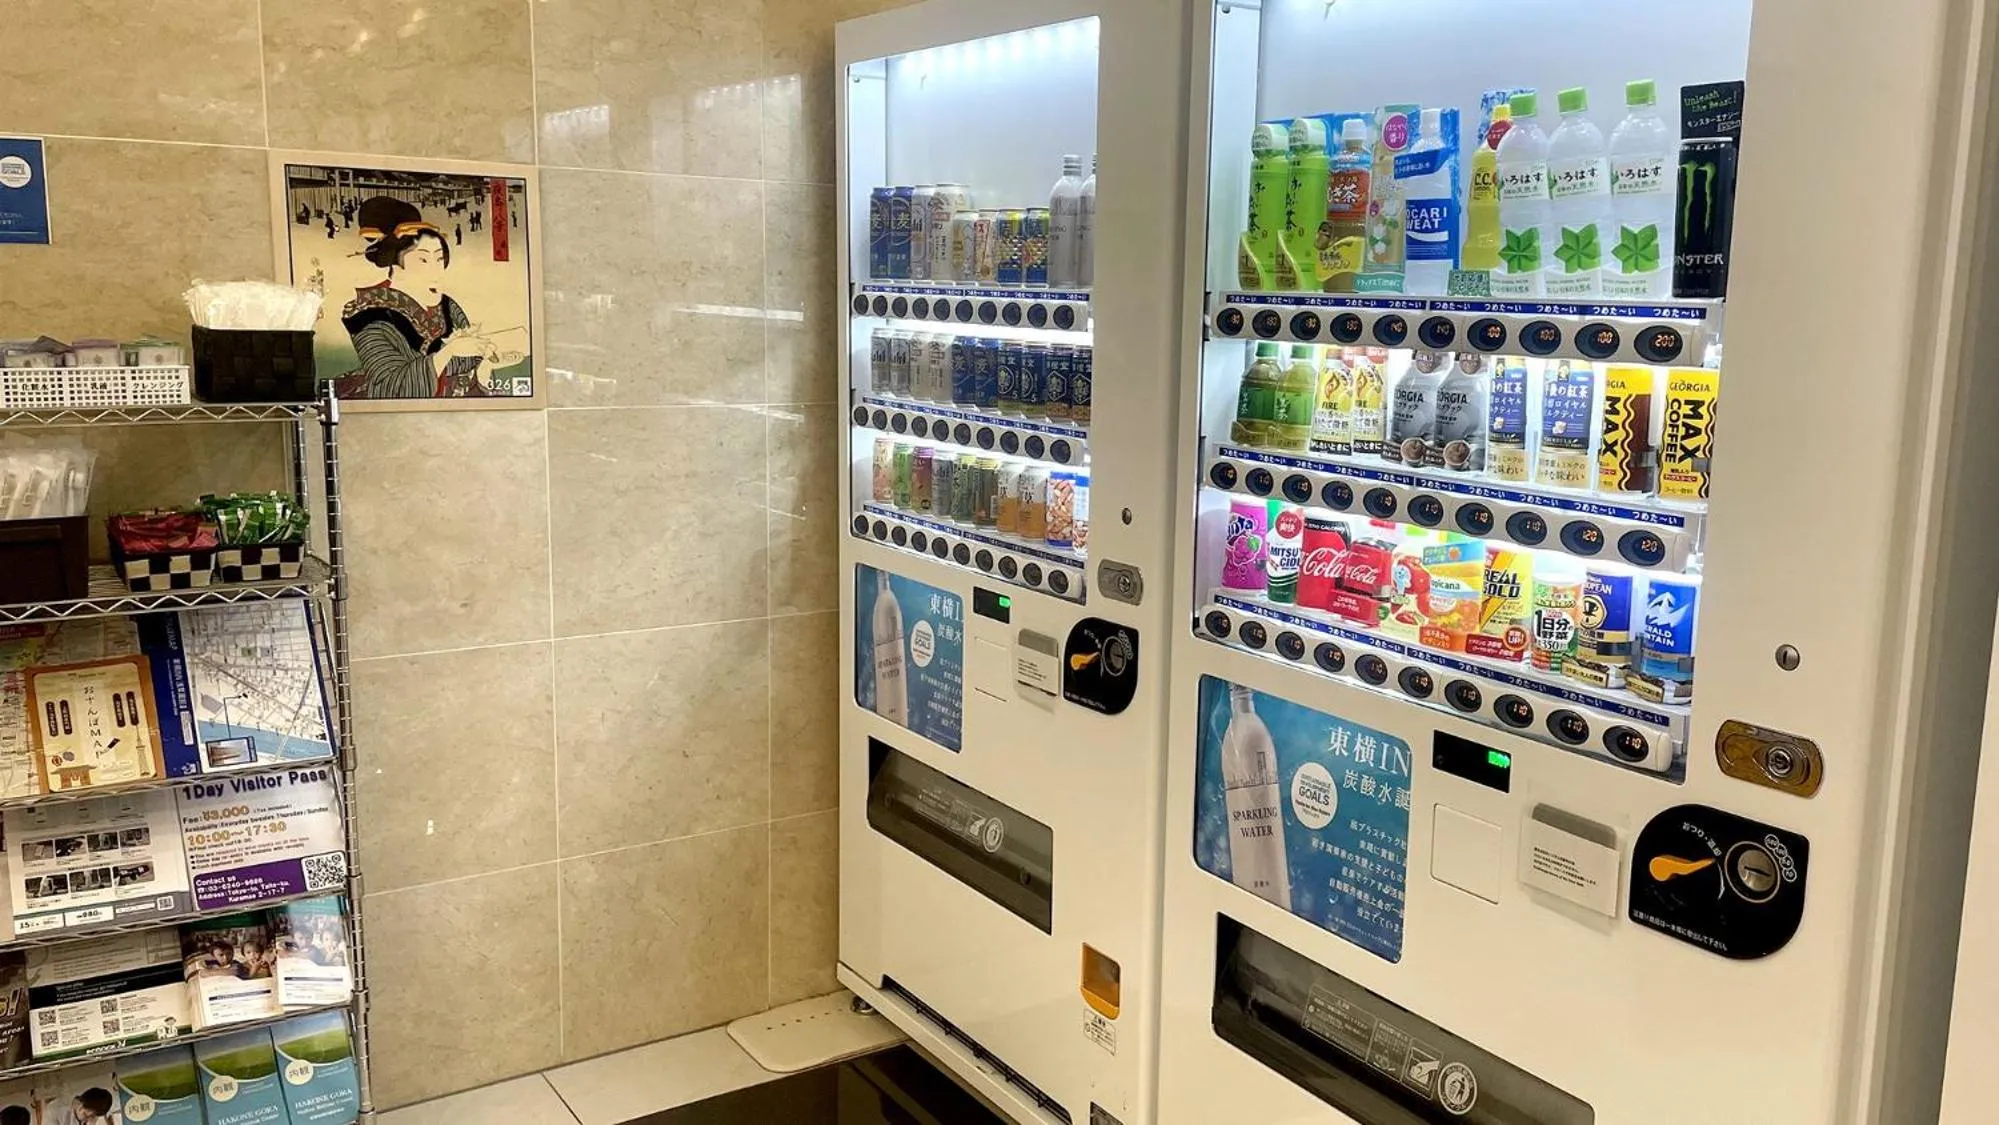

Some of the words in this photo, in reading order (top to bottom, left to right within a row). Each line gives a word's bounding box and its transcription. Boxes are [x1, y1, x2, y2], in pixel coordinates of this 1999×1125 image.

[1502, 172, 1544, 185] いろはす
[1554, 167, 1597, 182] いろはす
[1619, 165, 1662, 180] いろはす
[1406, 206, 1447, 219] OCARI
[1406, 218, 1440, 230] WEAT
[1435, 302, 1471, 310] つめた～い
[1484, 303, 1522, 312] つめた～い
[1536, 304, 1577, 314] つめた～い
[1592, 306, 1636, 316] つめた～い
[1652, 308, 1700, 318] つめた～い
[131, 381, 184, 389] クレンジング
[1669, 382, 1711, 392] GEORGIA
[1322, 401, 1339, 410] FIRE
[1602, 396, 1621, 458] MAX
[1665, 398, 1681, 464] COFFEE
[1678, 400, 1705, 464] MAX
[1270, 546, 1300, 557] MITSU
[1280, 558, 1300, 567] CID
[1484, 569, 1520, 585] REAL
[1328, 726, 1411, 777] 東横IN
[182, 783, 224, 800] 1Day
[230, 774, 283, 794] Visitor
[288, 769, 328, 785] Pass
[1299, 786, 1330, 806] GOALS
[1232, 806, 1278, 822] SPARKLING
[1240, 825, 1274, 839] WATER
